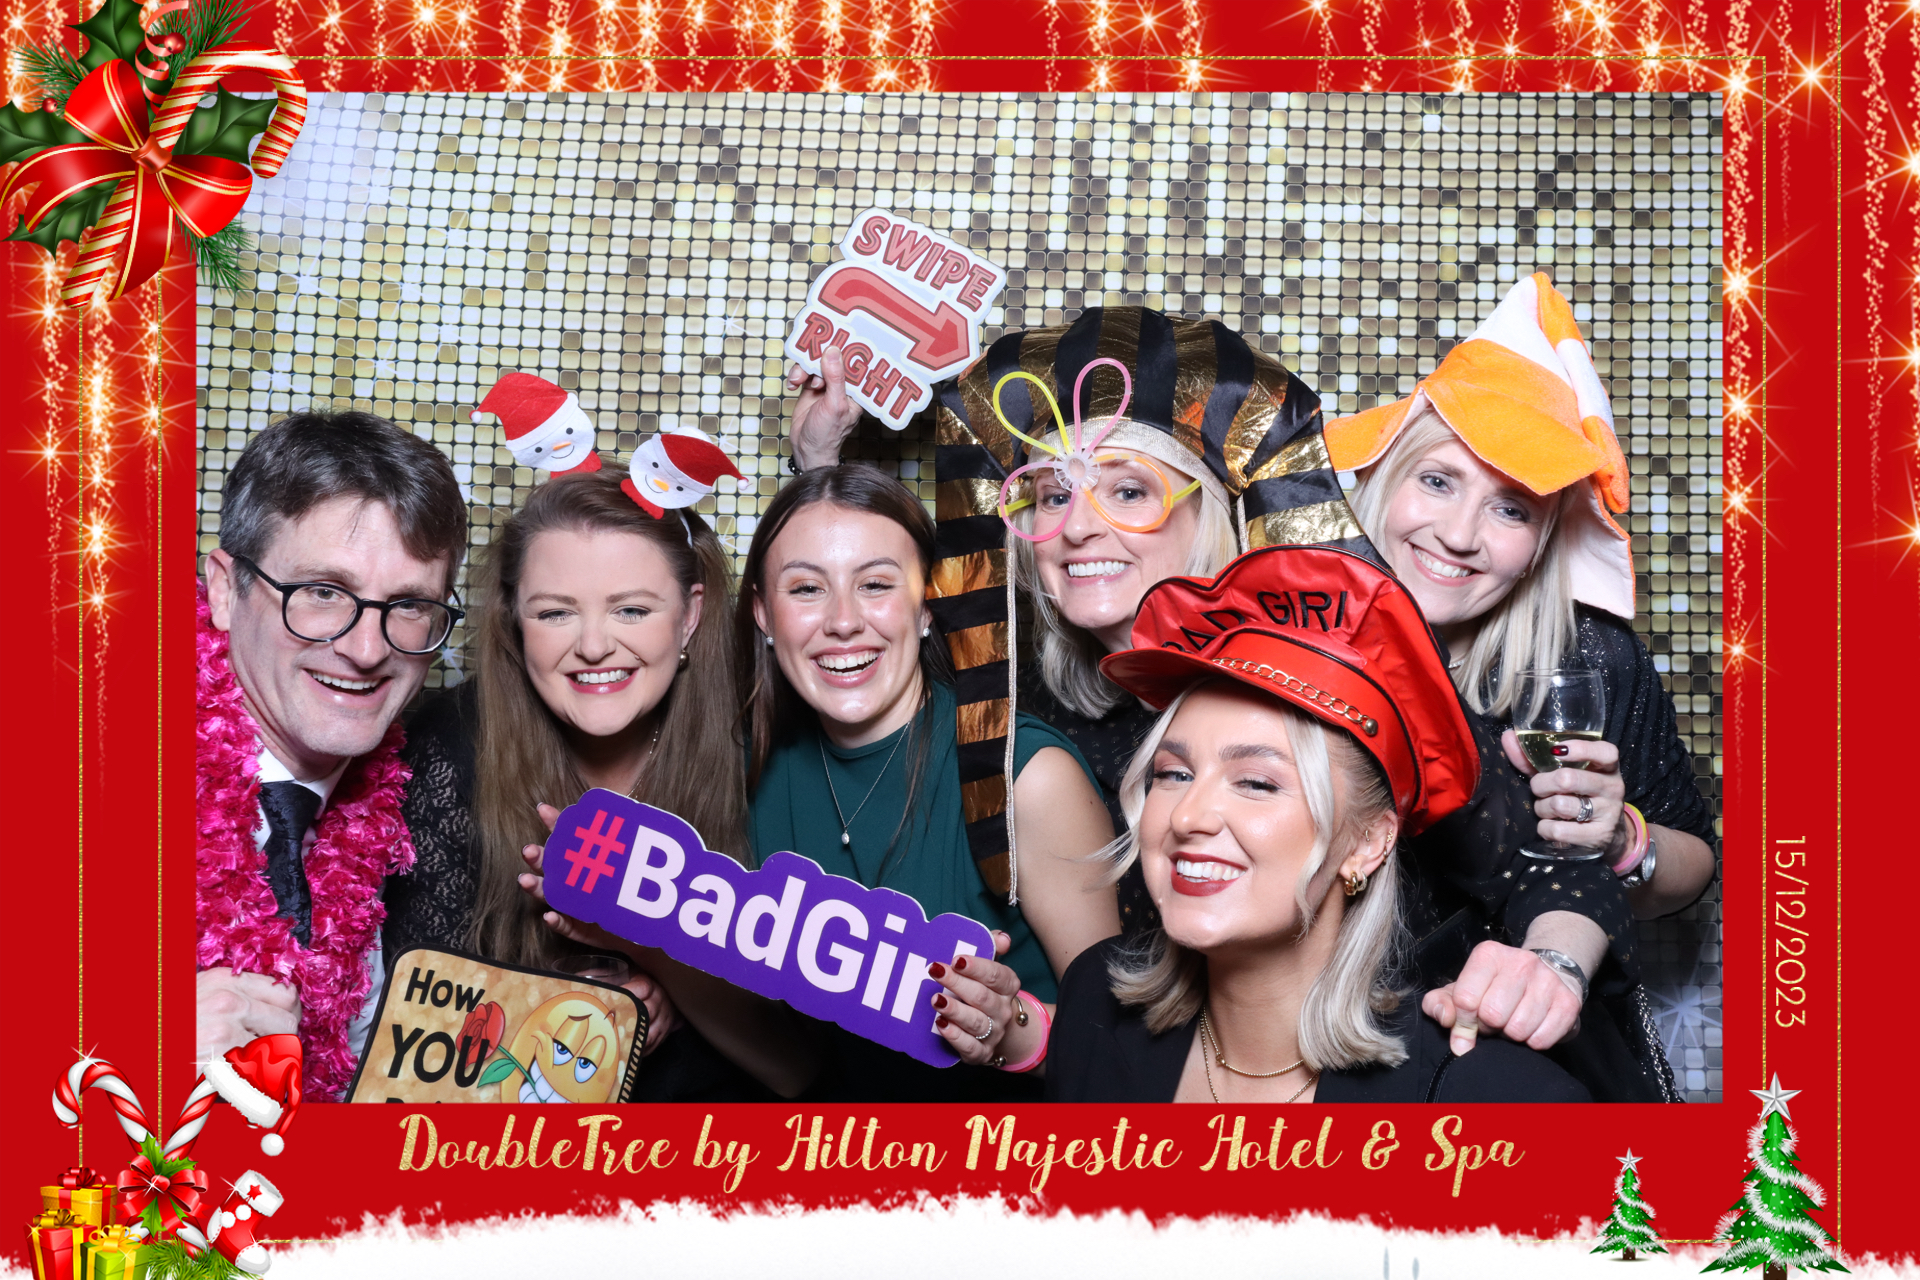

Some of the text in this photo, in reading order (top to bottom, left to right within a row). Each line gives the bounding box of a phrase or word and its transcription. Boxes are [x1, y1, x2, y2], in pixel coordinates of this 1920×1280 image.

[853, 216, 997, 312] SWIPE
[795, 312, 923, 420] RIGHT
[1161, 610, 1245, 654] AD
[404, 967, 485, 1013] How
[387, 1024, 490, 1088] YOU
